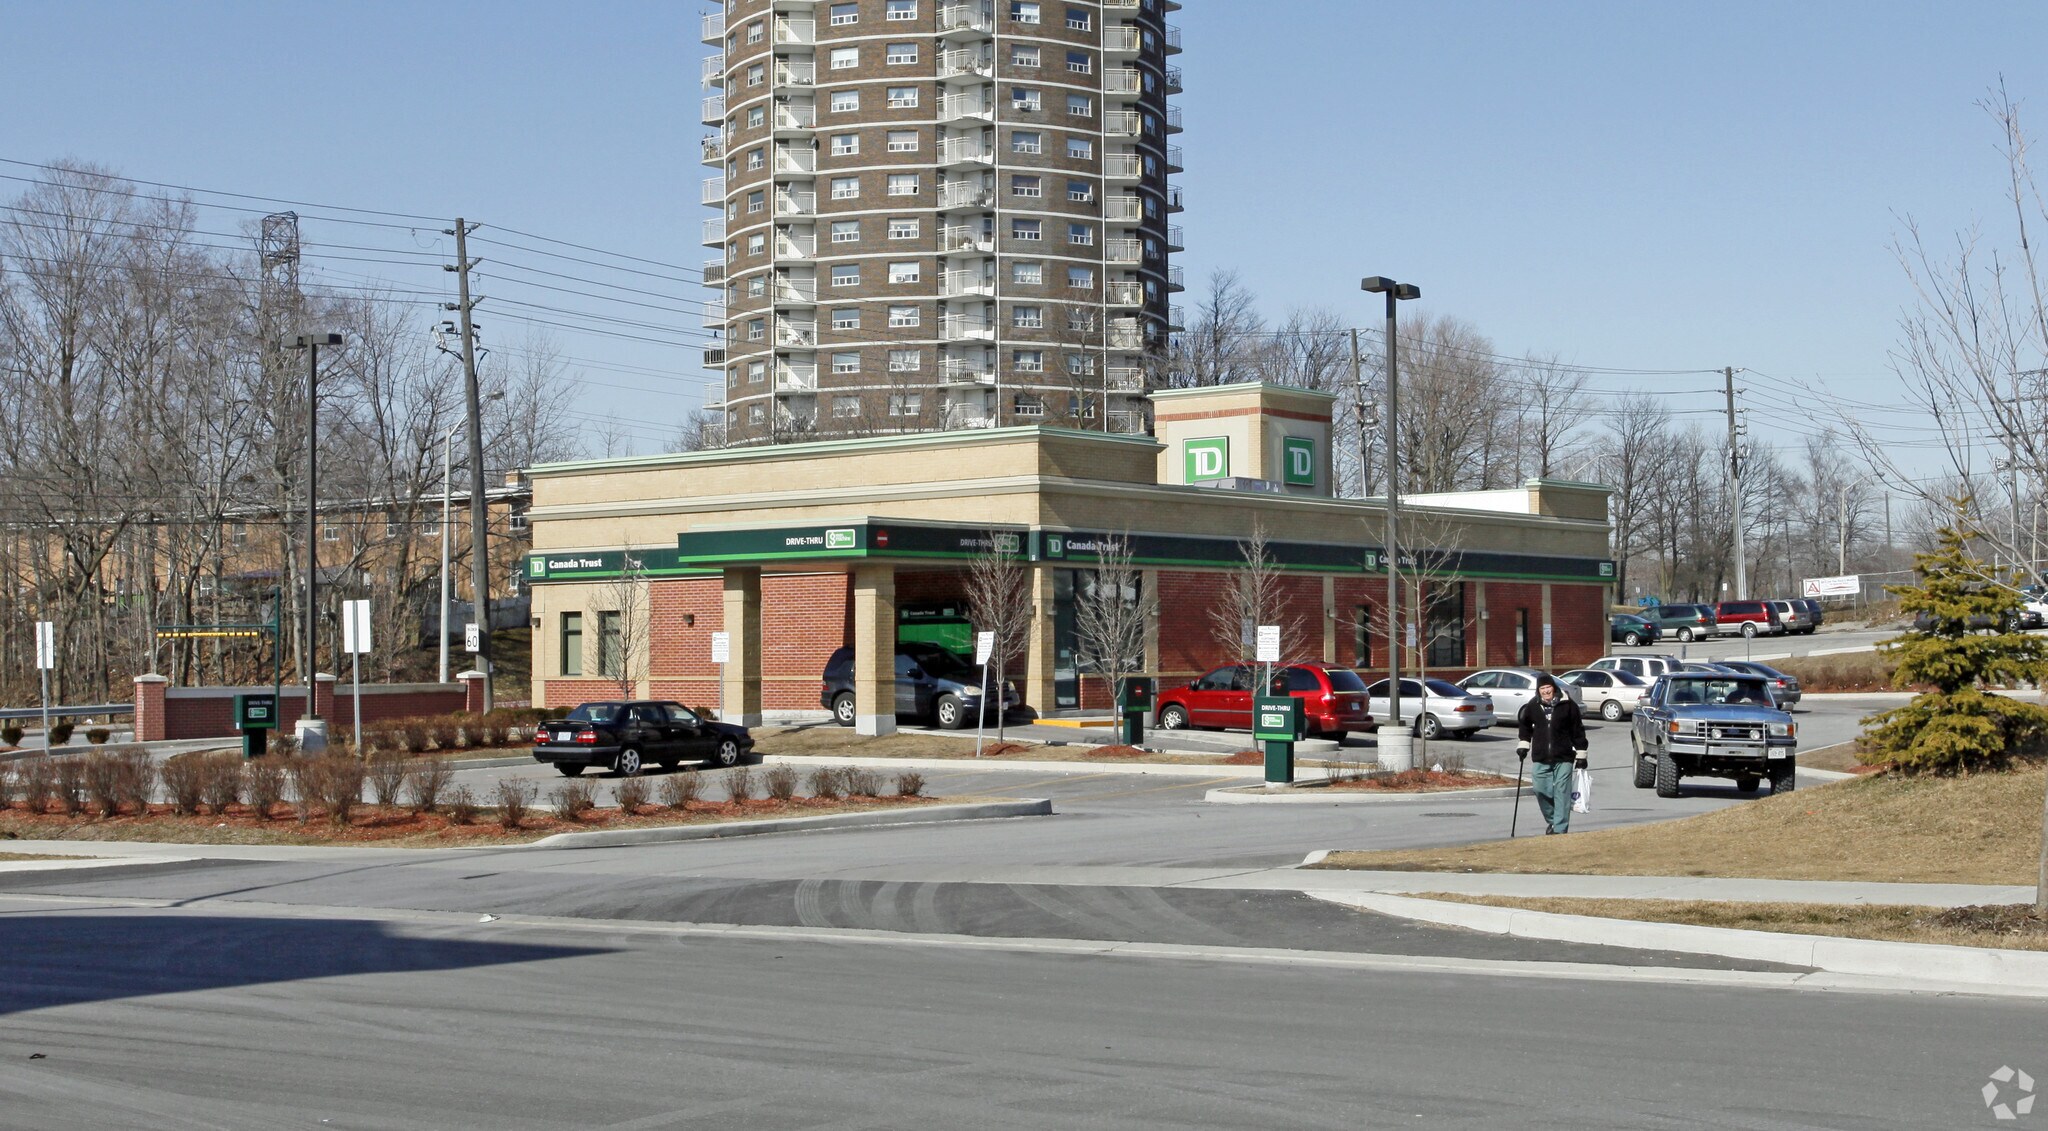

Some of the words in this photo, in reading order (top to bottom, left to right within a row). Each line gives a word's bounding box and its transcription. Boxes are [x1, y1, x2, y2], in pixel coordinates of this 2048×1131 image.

[1188, 447, 1222, 475] TD
[1289, 446, 1311, 475] TD
[785, 536, 823, 546] DRIVE-THRU
[1049, 539, 1061, 553] TD
[1066, 540, 1096, 551] Canada
[532, 561, 543, 573] TD
[549, 560, 578, 569] Canada
[579, 558, 602, 568] Trust
[1366, 554, 1376, 566] TD
[466, 635, 478, 648] 60
